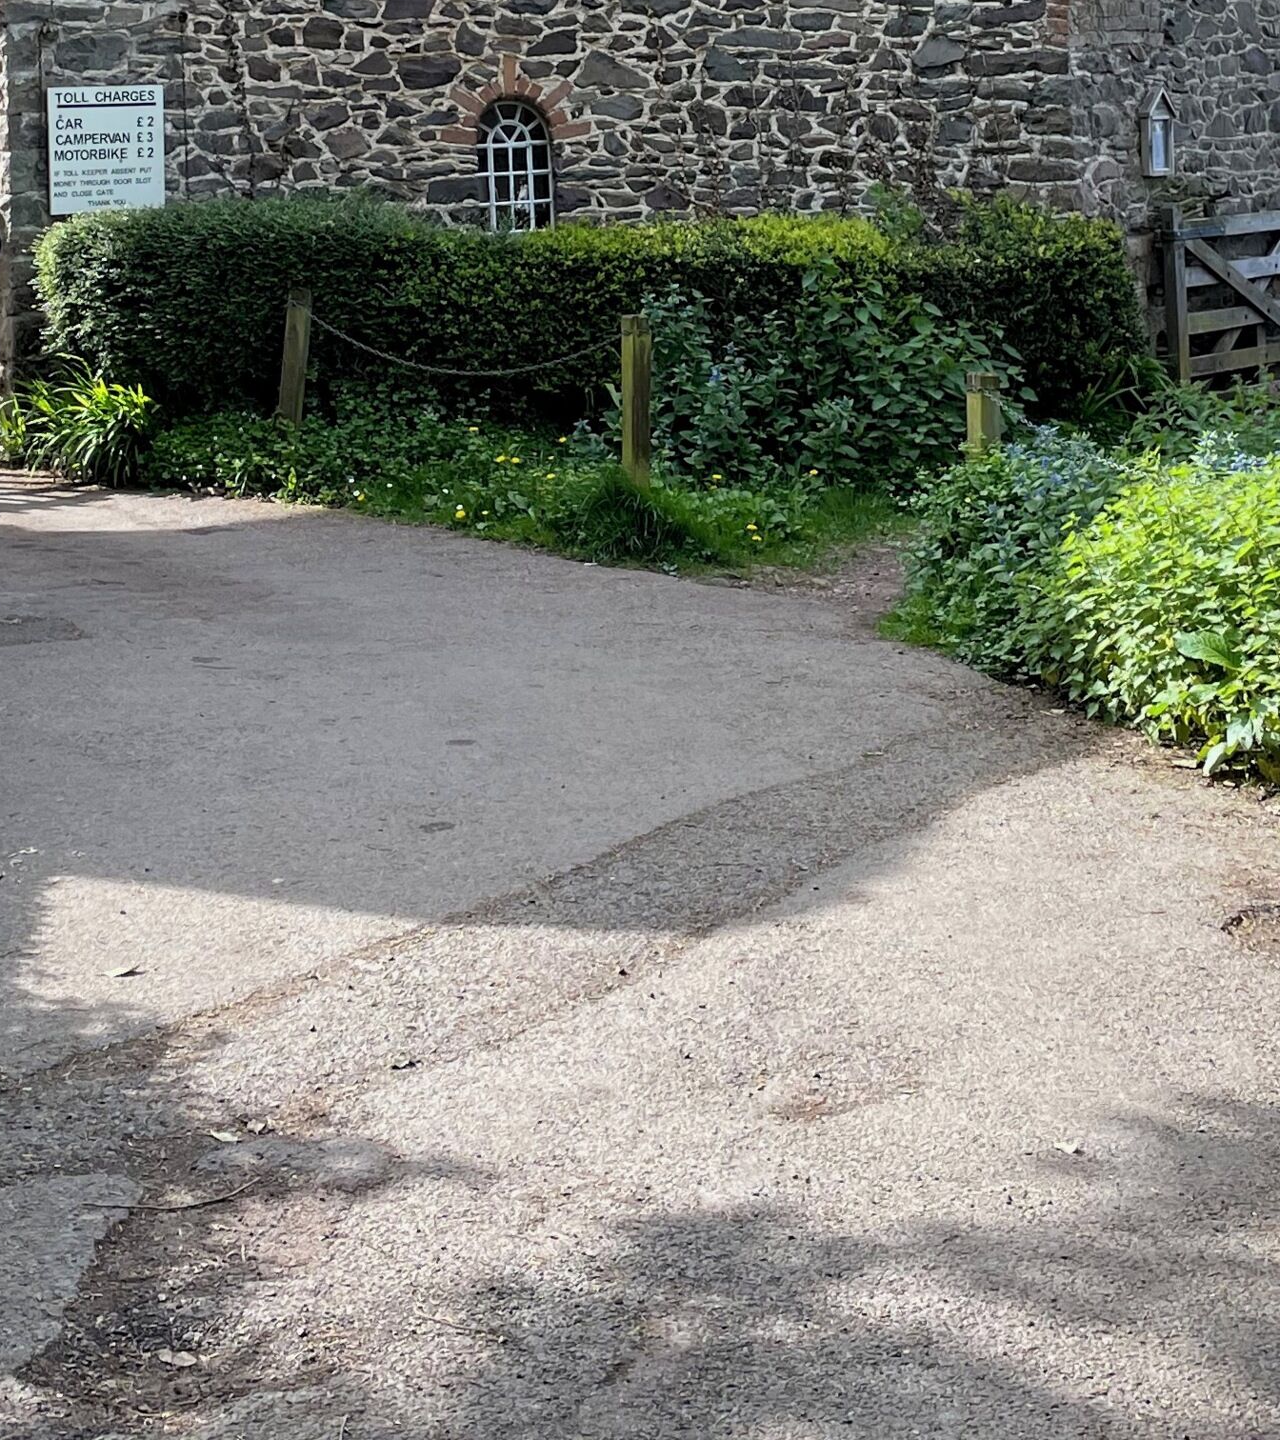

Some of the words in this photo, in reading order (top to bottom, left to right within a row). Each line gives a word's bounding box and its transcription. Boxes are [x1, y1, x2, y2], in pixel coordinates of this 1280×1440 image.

[55, 92, 89, 104] TOLL
[95, 90, 155, 102] CHARGES
[56, 119, 83, 130] CAR
[56, 133, 130, 146] CAMPERVAN
[54, 148, 128, 161] MOTORBIKE
